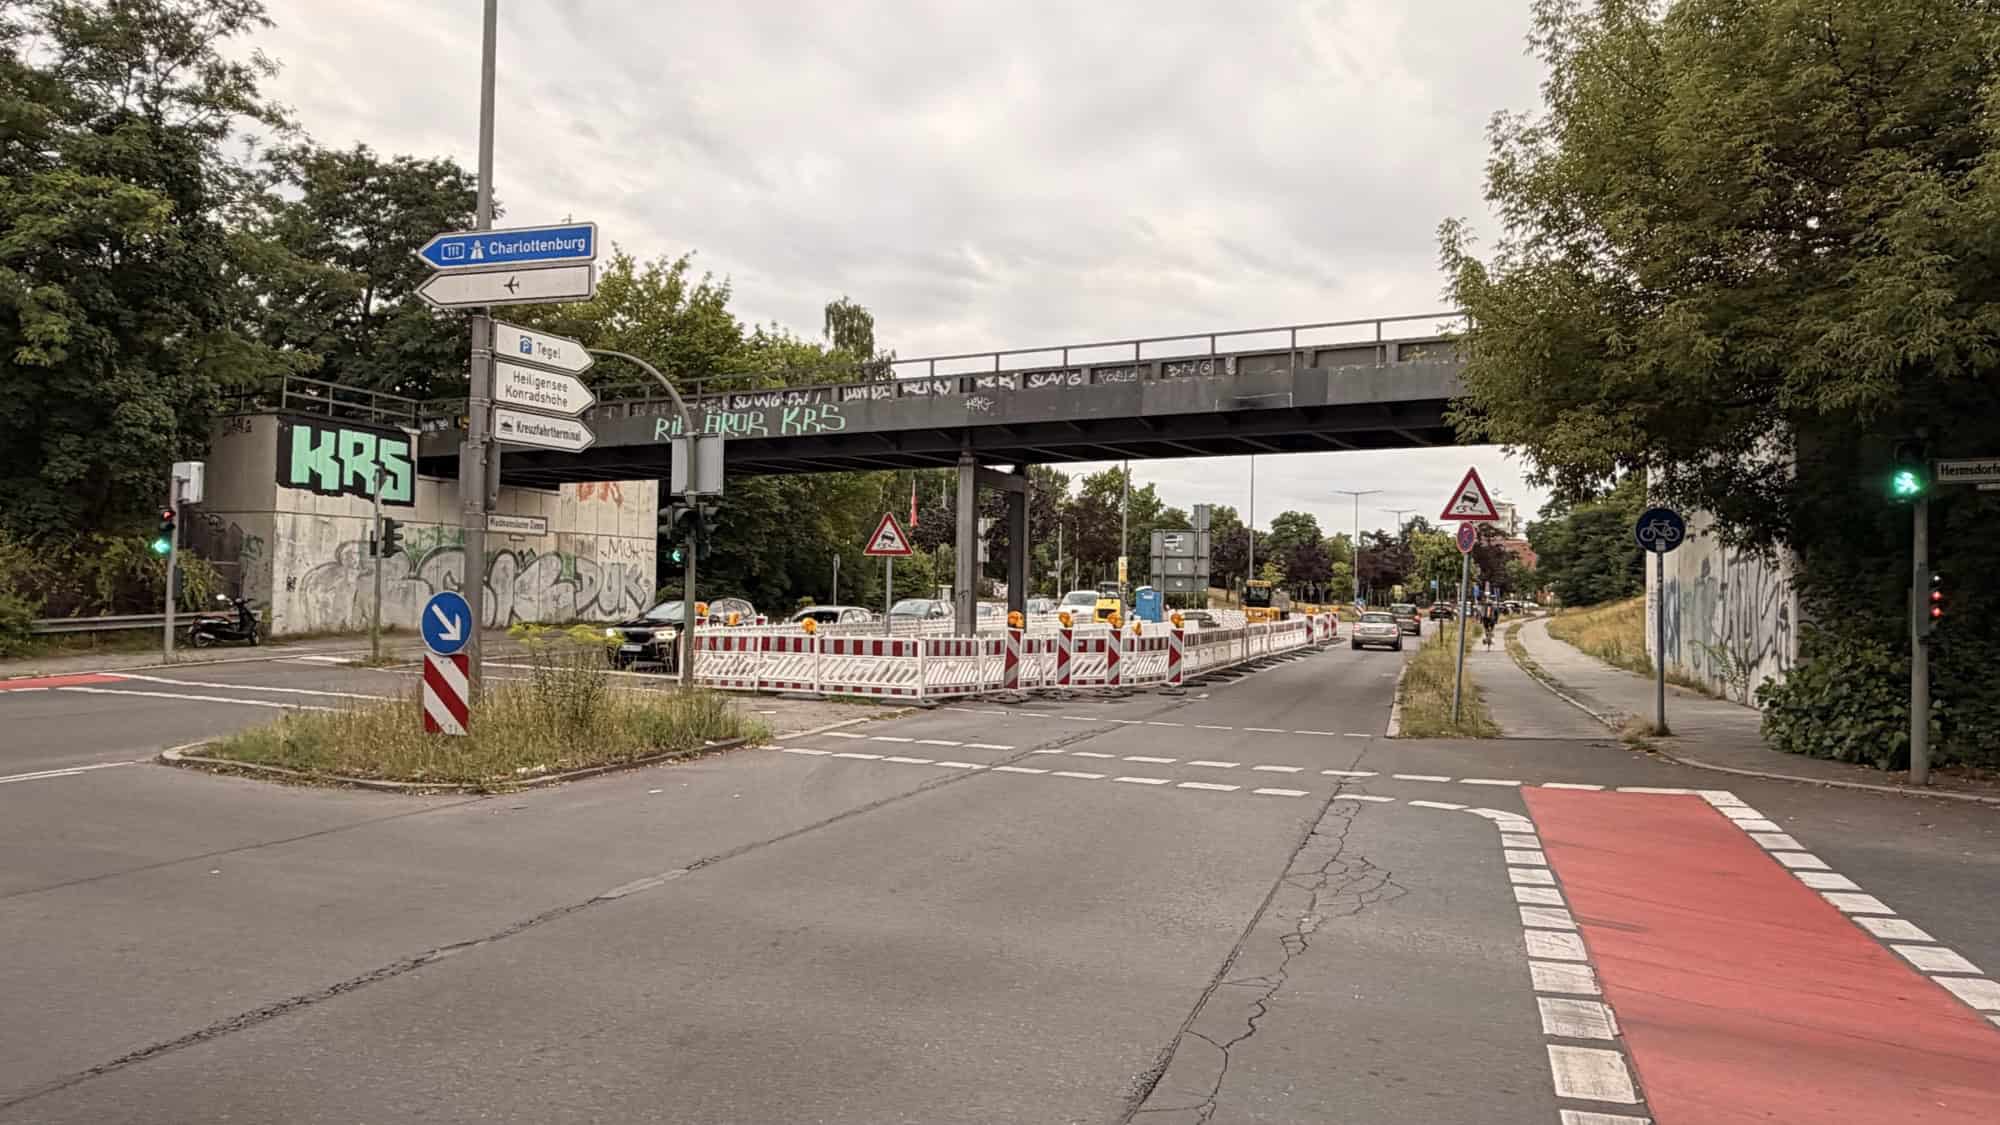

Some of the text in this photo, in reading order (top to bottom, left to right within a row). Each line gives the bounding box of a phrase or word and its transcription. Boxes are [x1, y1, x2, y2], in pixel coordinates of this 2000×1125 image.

[447, 237, 586, 257] 111 Charlottenburg
[536, 342, 561, 360] Tegel
[513, 370, 568, 392] Heiligensee
[505, 384, 568, 407] Konradshöhe
[290, 424, 412, 502] KRS
